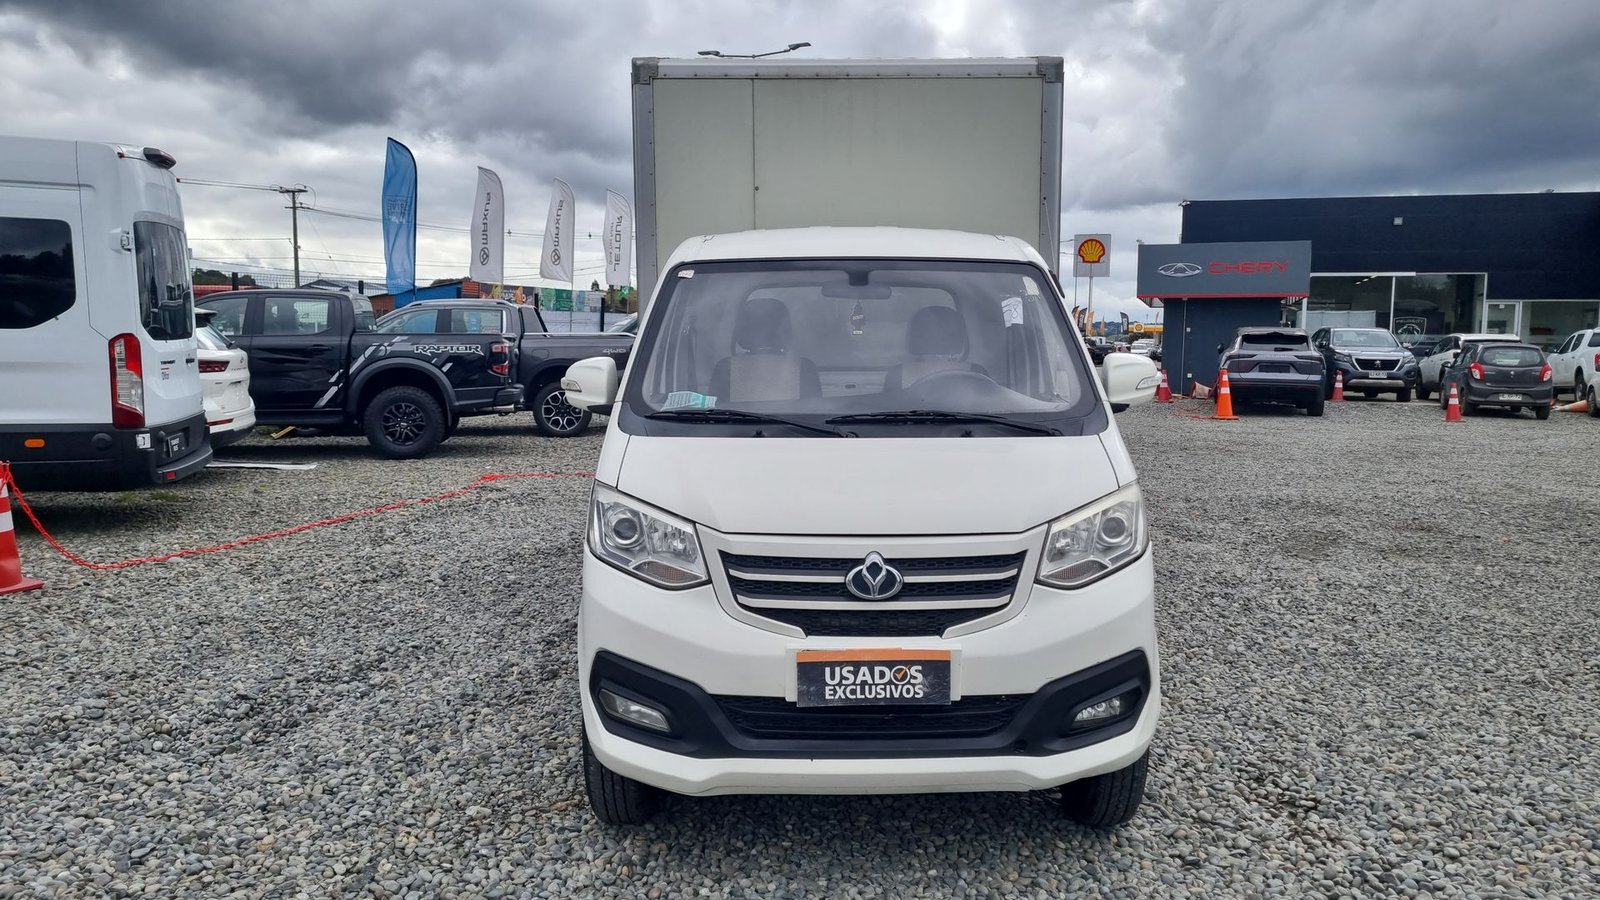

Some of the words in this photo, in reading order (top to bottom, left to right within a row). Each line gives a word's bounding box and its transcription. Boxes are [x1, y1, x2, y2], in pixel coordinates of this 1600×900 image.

[1207, 260, 1290, 275] CHERY
[414, 344, 484, 356] RAPTOR
[824, 665, 923, 685] USADOS
[825, 684, 924, 700] EXCLUSIVOS
